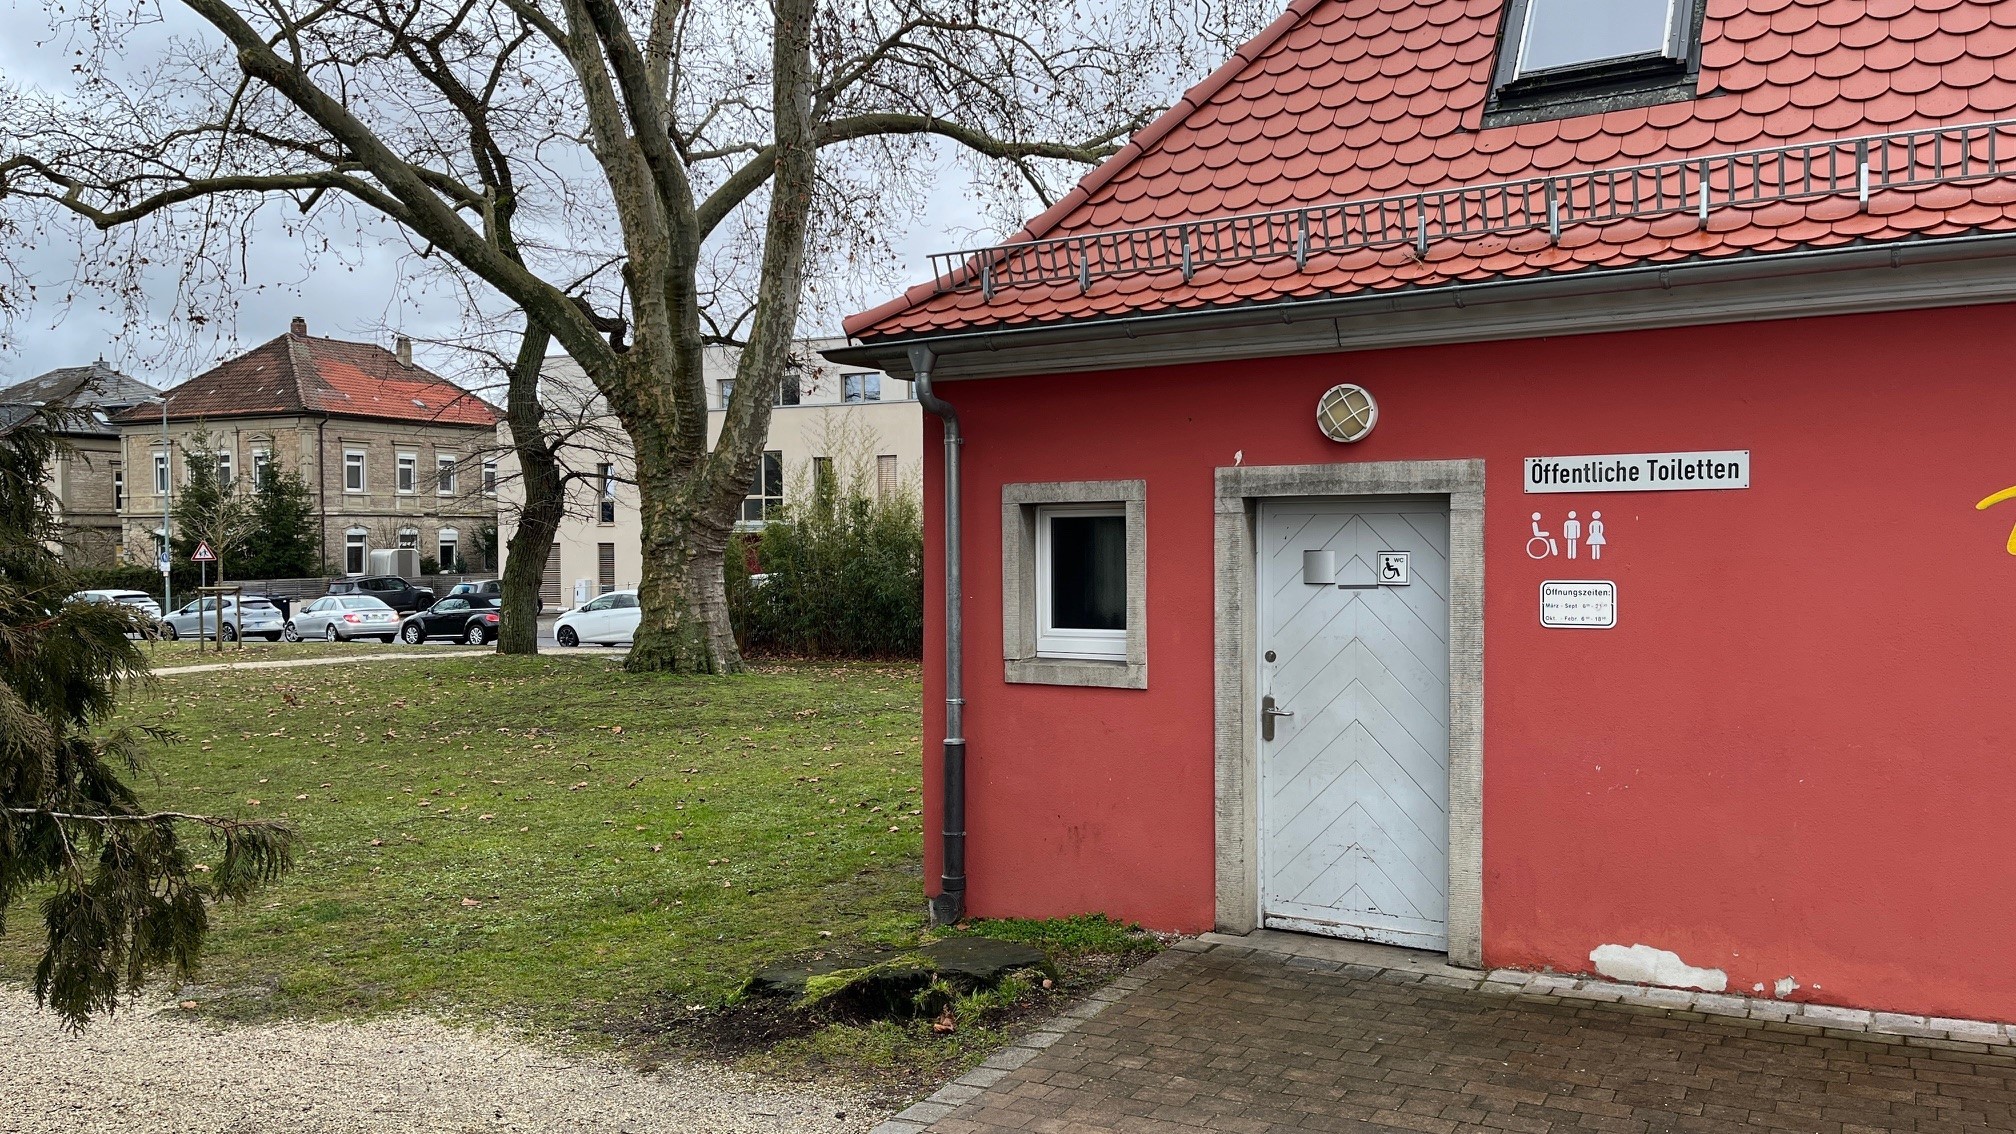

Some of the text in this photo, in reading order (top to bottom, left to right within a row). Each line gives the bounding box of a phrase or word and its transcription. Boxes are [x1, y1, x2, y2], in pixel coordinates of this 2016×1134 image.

[1531, 458, 1740, 484] Öffentliche Toiletten
[1545, 586, 1611, 598] Öffnungszeiten:
